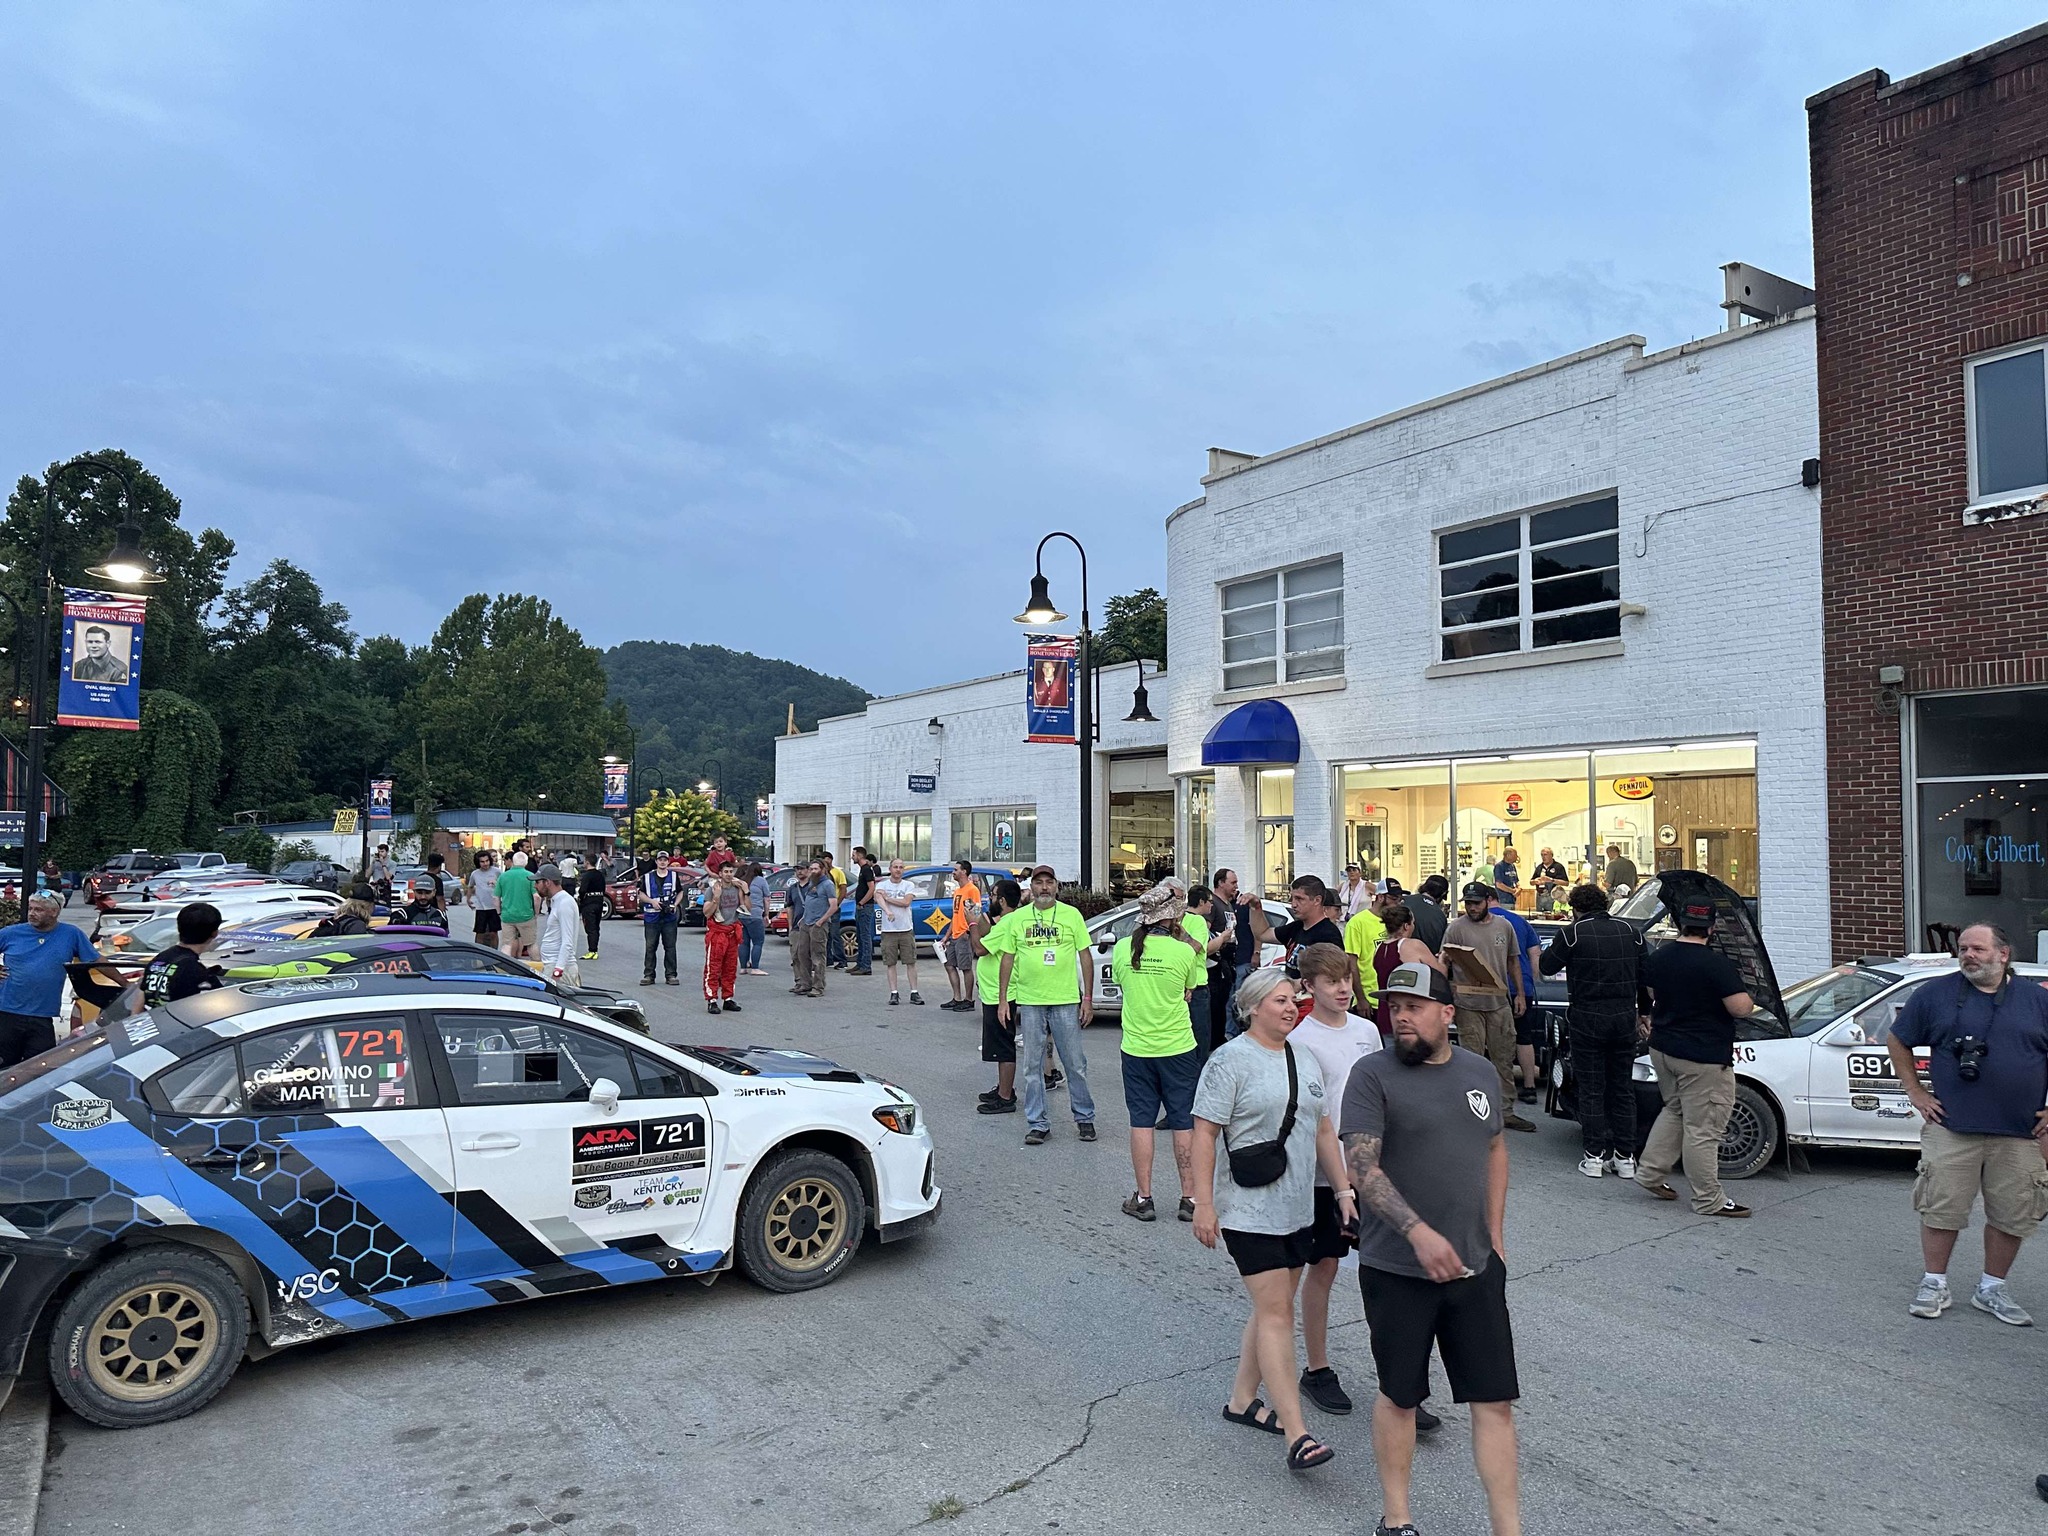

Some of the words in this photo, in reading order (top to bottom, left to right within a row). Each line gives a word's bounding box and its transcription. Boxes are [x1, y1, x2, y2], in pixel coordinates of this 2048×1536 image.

[68, 609, 117, 620] HOMETOWN
[118, 615, 142, 623] HERO
[1619, 781, 1649, 791] PENNZOIL
[338, 811, 356, 822] CASH
[1945, 836, 1977, 871] Coy,
[1986, 836, 2045, 868] Gilbert,
[338, 1029, 404, 1057] 721
[1849, 1056, 1896, 1076] 691
[254, 1064, 372, 1086] GELSOMINO
[280, 1083, 371, 1101] MARTELL
[58, 1101, 80, 1109] BACK
[54, 1115, 110, 1130] APPALACHIA
[653, 1121, 694, 1145] 721
[579, 1144, 614, 1153] AMERICAN
[583, 1163, 601, 1173] The
[604, 1160, 634, 1171] Boone
[637, 1154, 668, 1166] Forest
[672, 1150, 696, 1161] Rally
[633, 1181, 685, 1196] KENTUCKY
[638, 1176, 664, 1187] TEAM
[674, 1187, 703, 1198] GREEN
[676, 1196, 700, 1206] APU
[277, 1268, 340, 1303] VSC
[69, 1325, 85, 1368] YOKOHAMA
